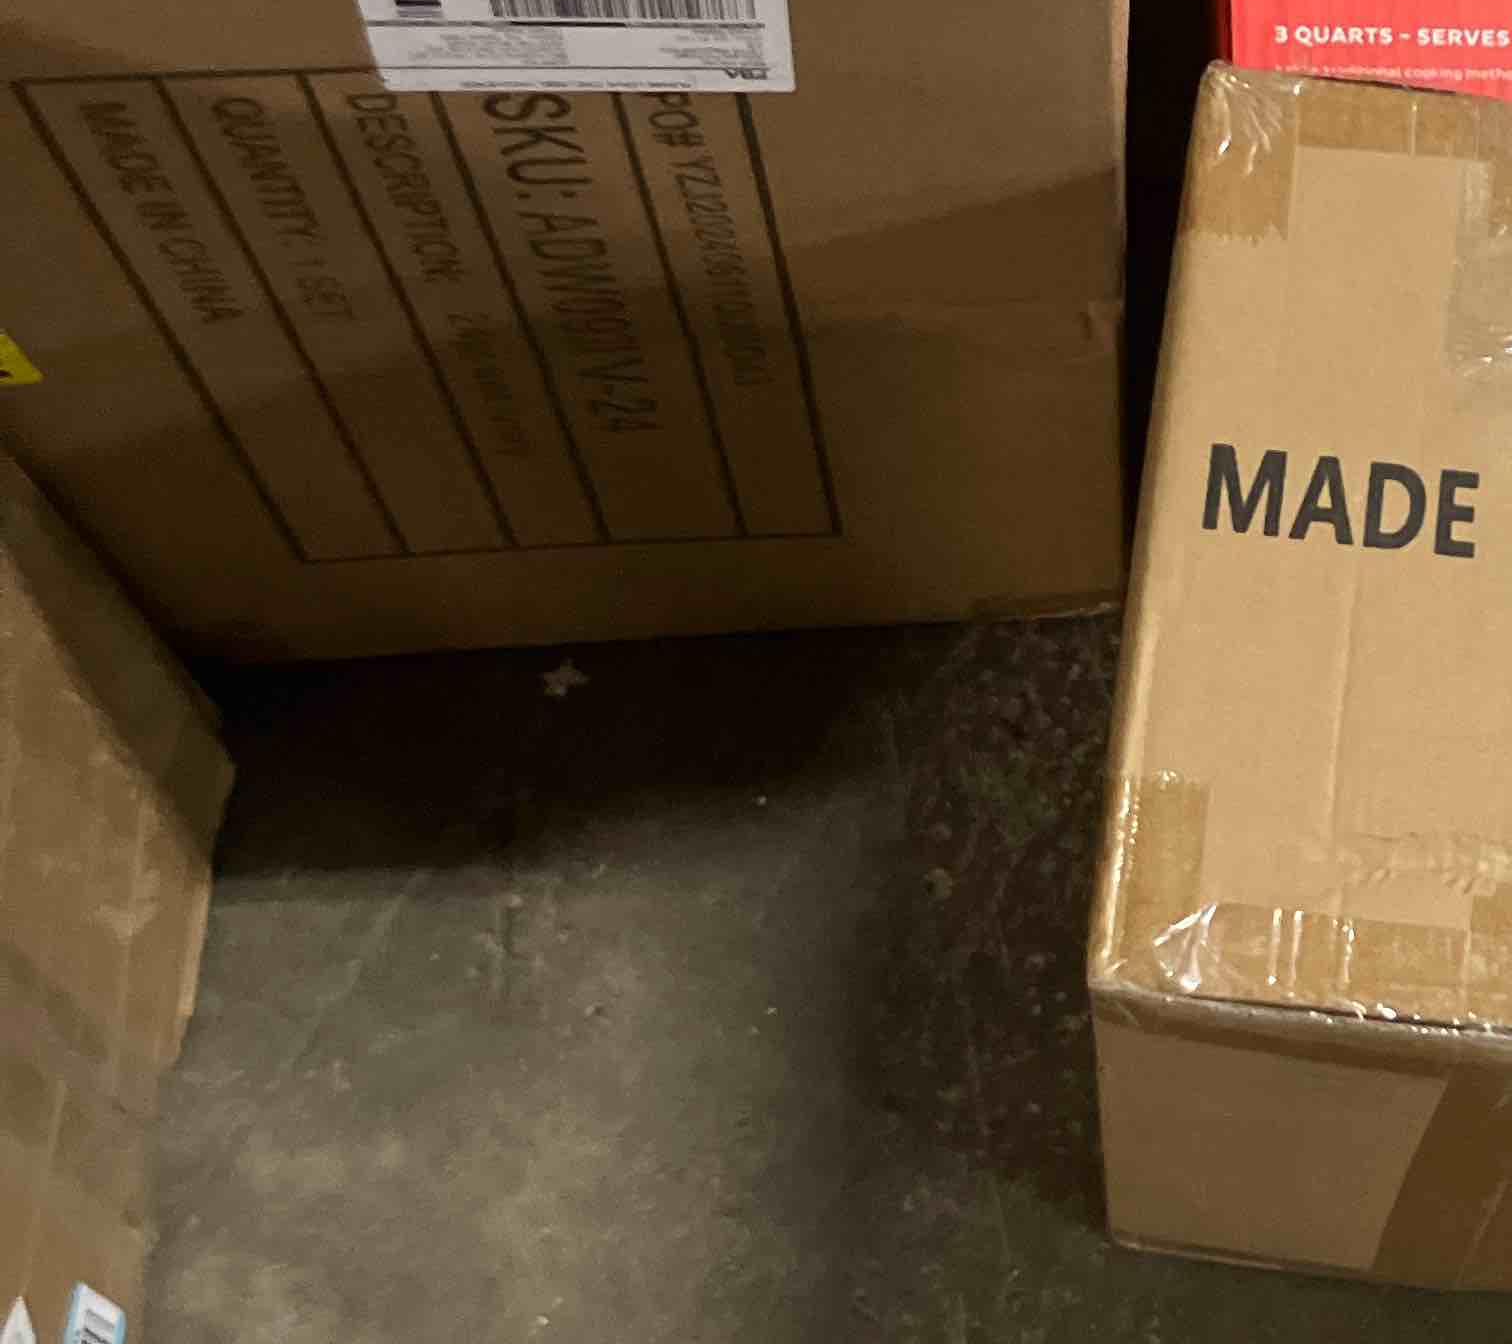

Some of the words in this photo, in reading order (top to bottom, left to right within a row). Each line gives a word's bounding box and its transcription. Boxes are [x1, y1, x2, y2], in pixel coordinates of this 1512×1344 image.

[1274, 25, 1288, 44] 3
[1293, 26, 1393, 46] QUARTS
[1416, 28, 1509, 48] SERVES
[484, 92, 591, 207] SKU:
[79, 100, 154, 193] MADE
[168, 237, 247, 325] CHINA
[1202, 443, 1480, 559] MADE
